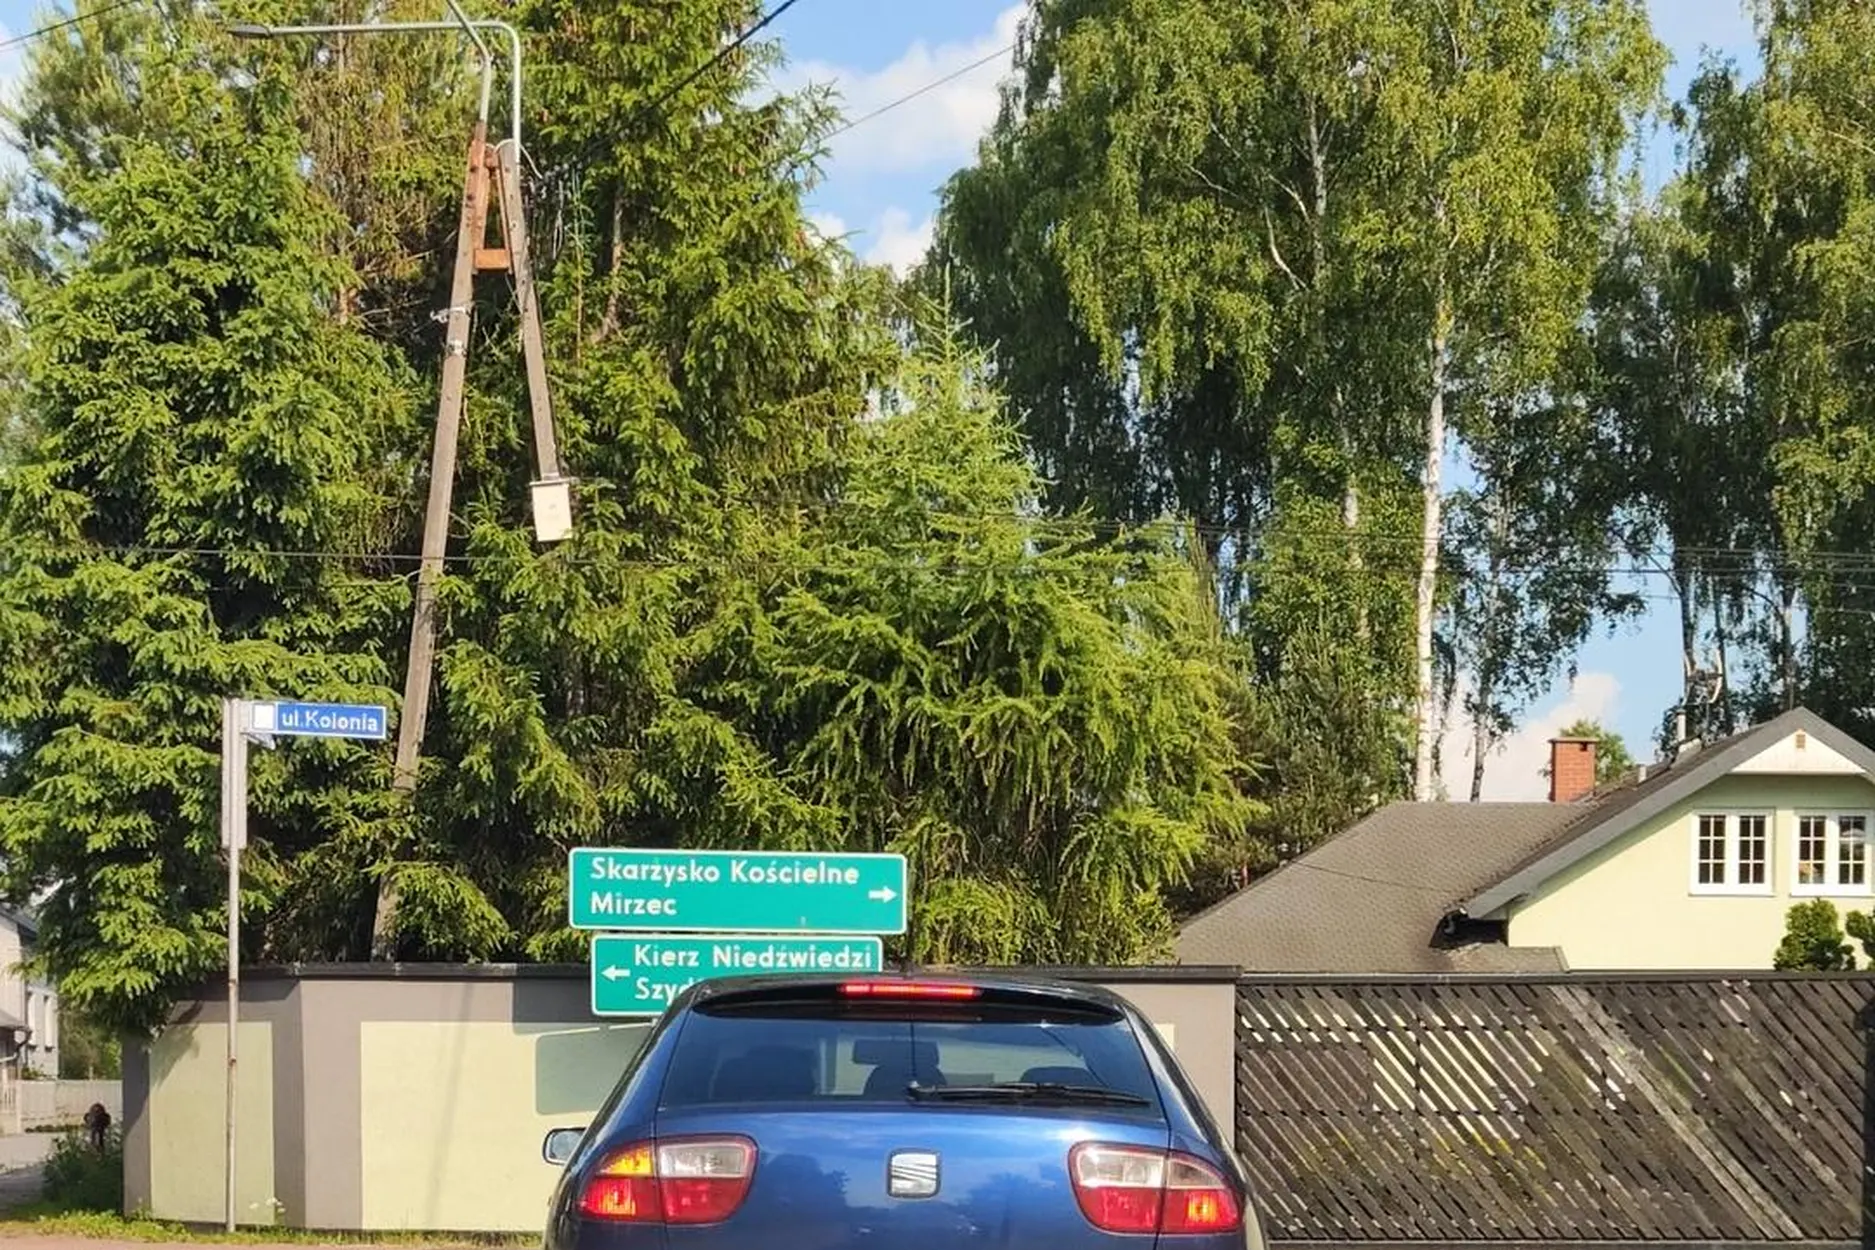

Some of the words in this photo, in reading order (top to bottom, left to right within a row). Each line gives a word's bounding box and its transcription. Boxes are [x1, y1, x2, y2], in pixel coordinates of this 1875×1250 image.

[730, 859, 860, 884] Kościelne
[590, 891, 677, 915] Mirzec
[634, 943, 700, 967] Kierz
[713, 944, 871, 968] Niedźwiedzi
